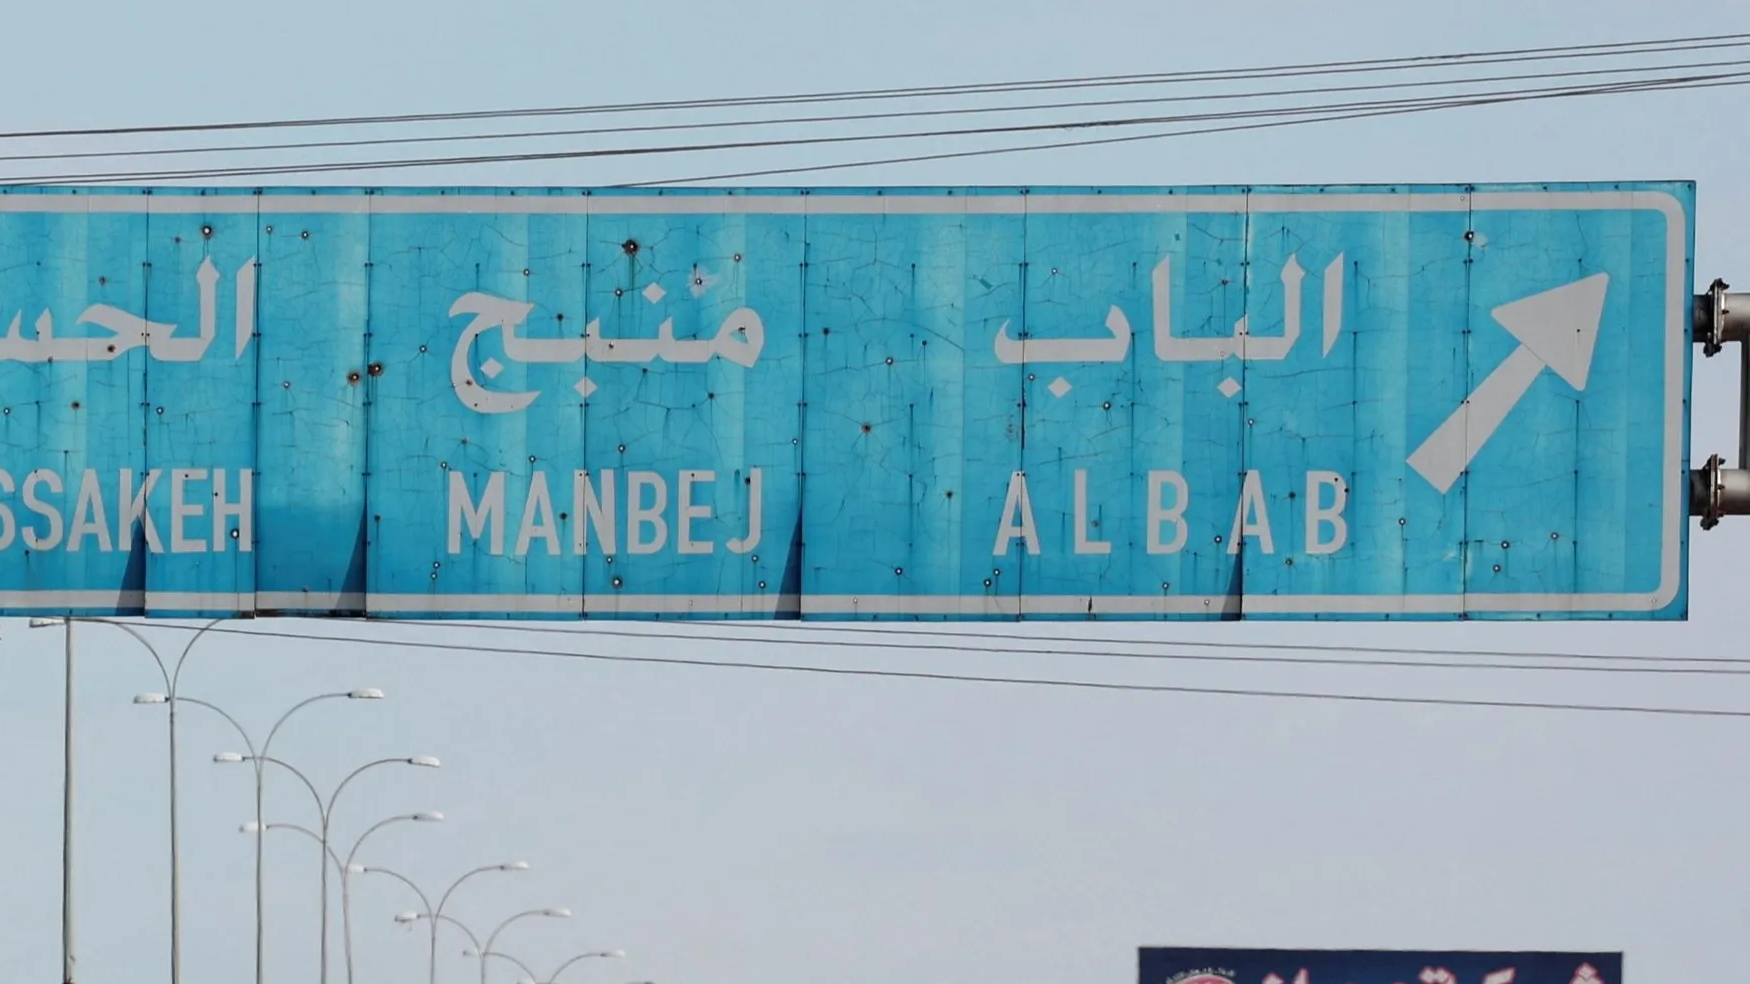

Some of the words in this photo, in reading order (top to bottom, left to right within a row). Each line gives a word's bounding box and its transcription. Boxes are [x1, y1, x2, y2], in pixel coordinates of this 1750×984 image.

[448, 281, 764, 414] منبج
[994, 252, 1343, 398] الباب
[448, 468, 762, 555] MANBEJ
